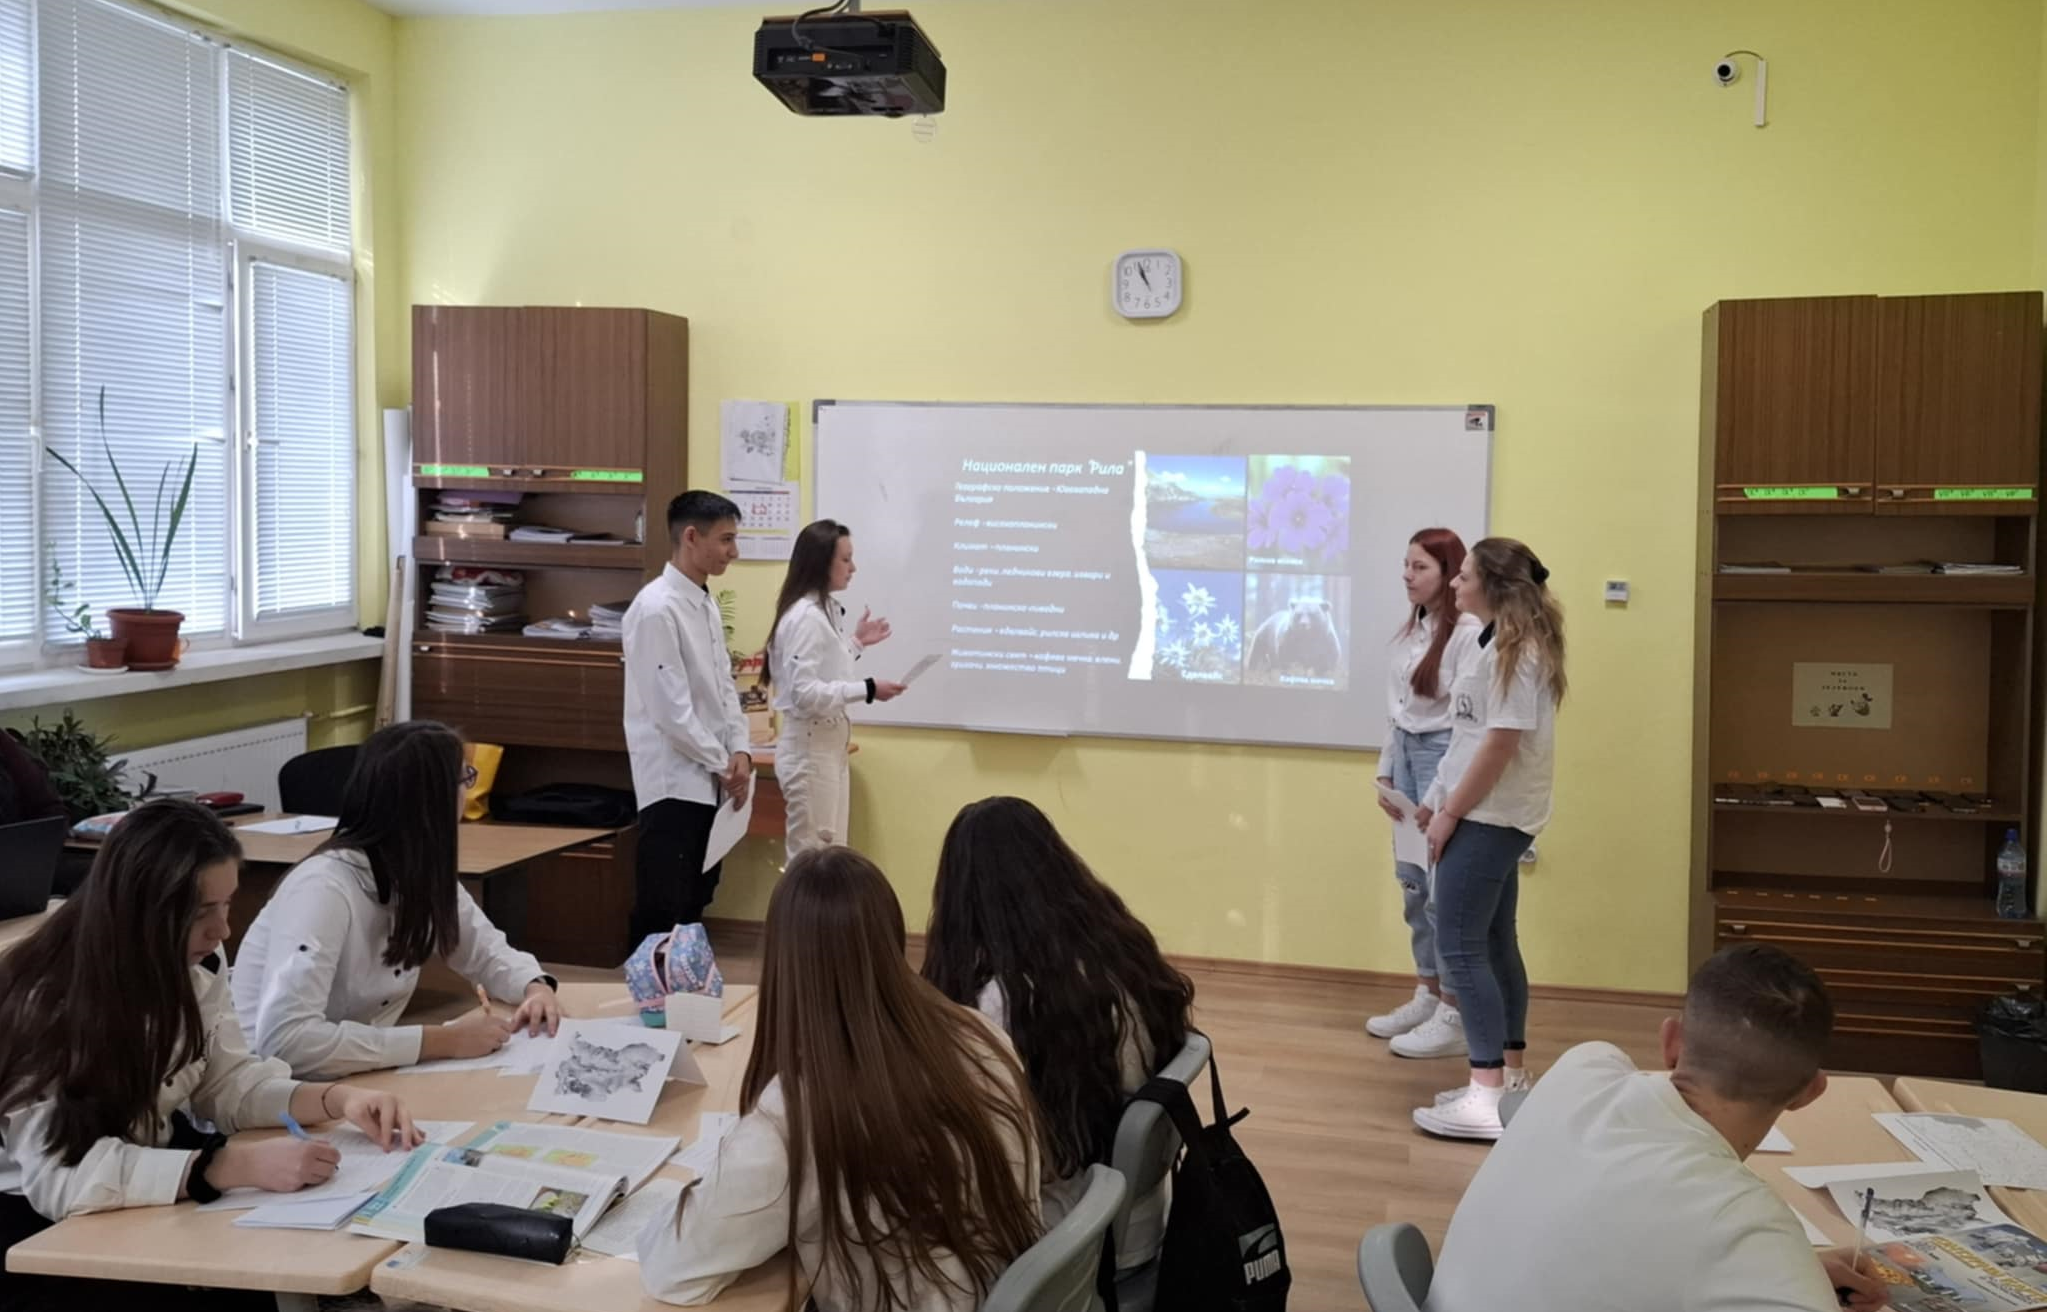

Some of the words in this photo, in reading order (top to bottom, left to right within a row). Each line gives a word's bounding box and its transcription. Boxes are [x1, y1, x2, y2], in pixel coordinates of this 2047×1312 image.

[962, 459, 1047, 475] Национален
[1048, 462, 1083, 476] парк
[1243, 1249, 1281, 1285] PUMA
